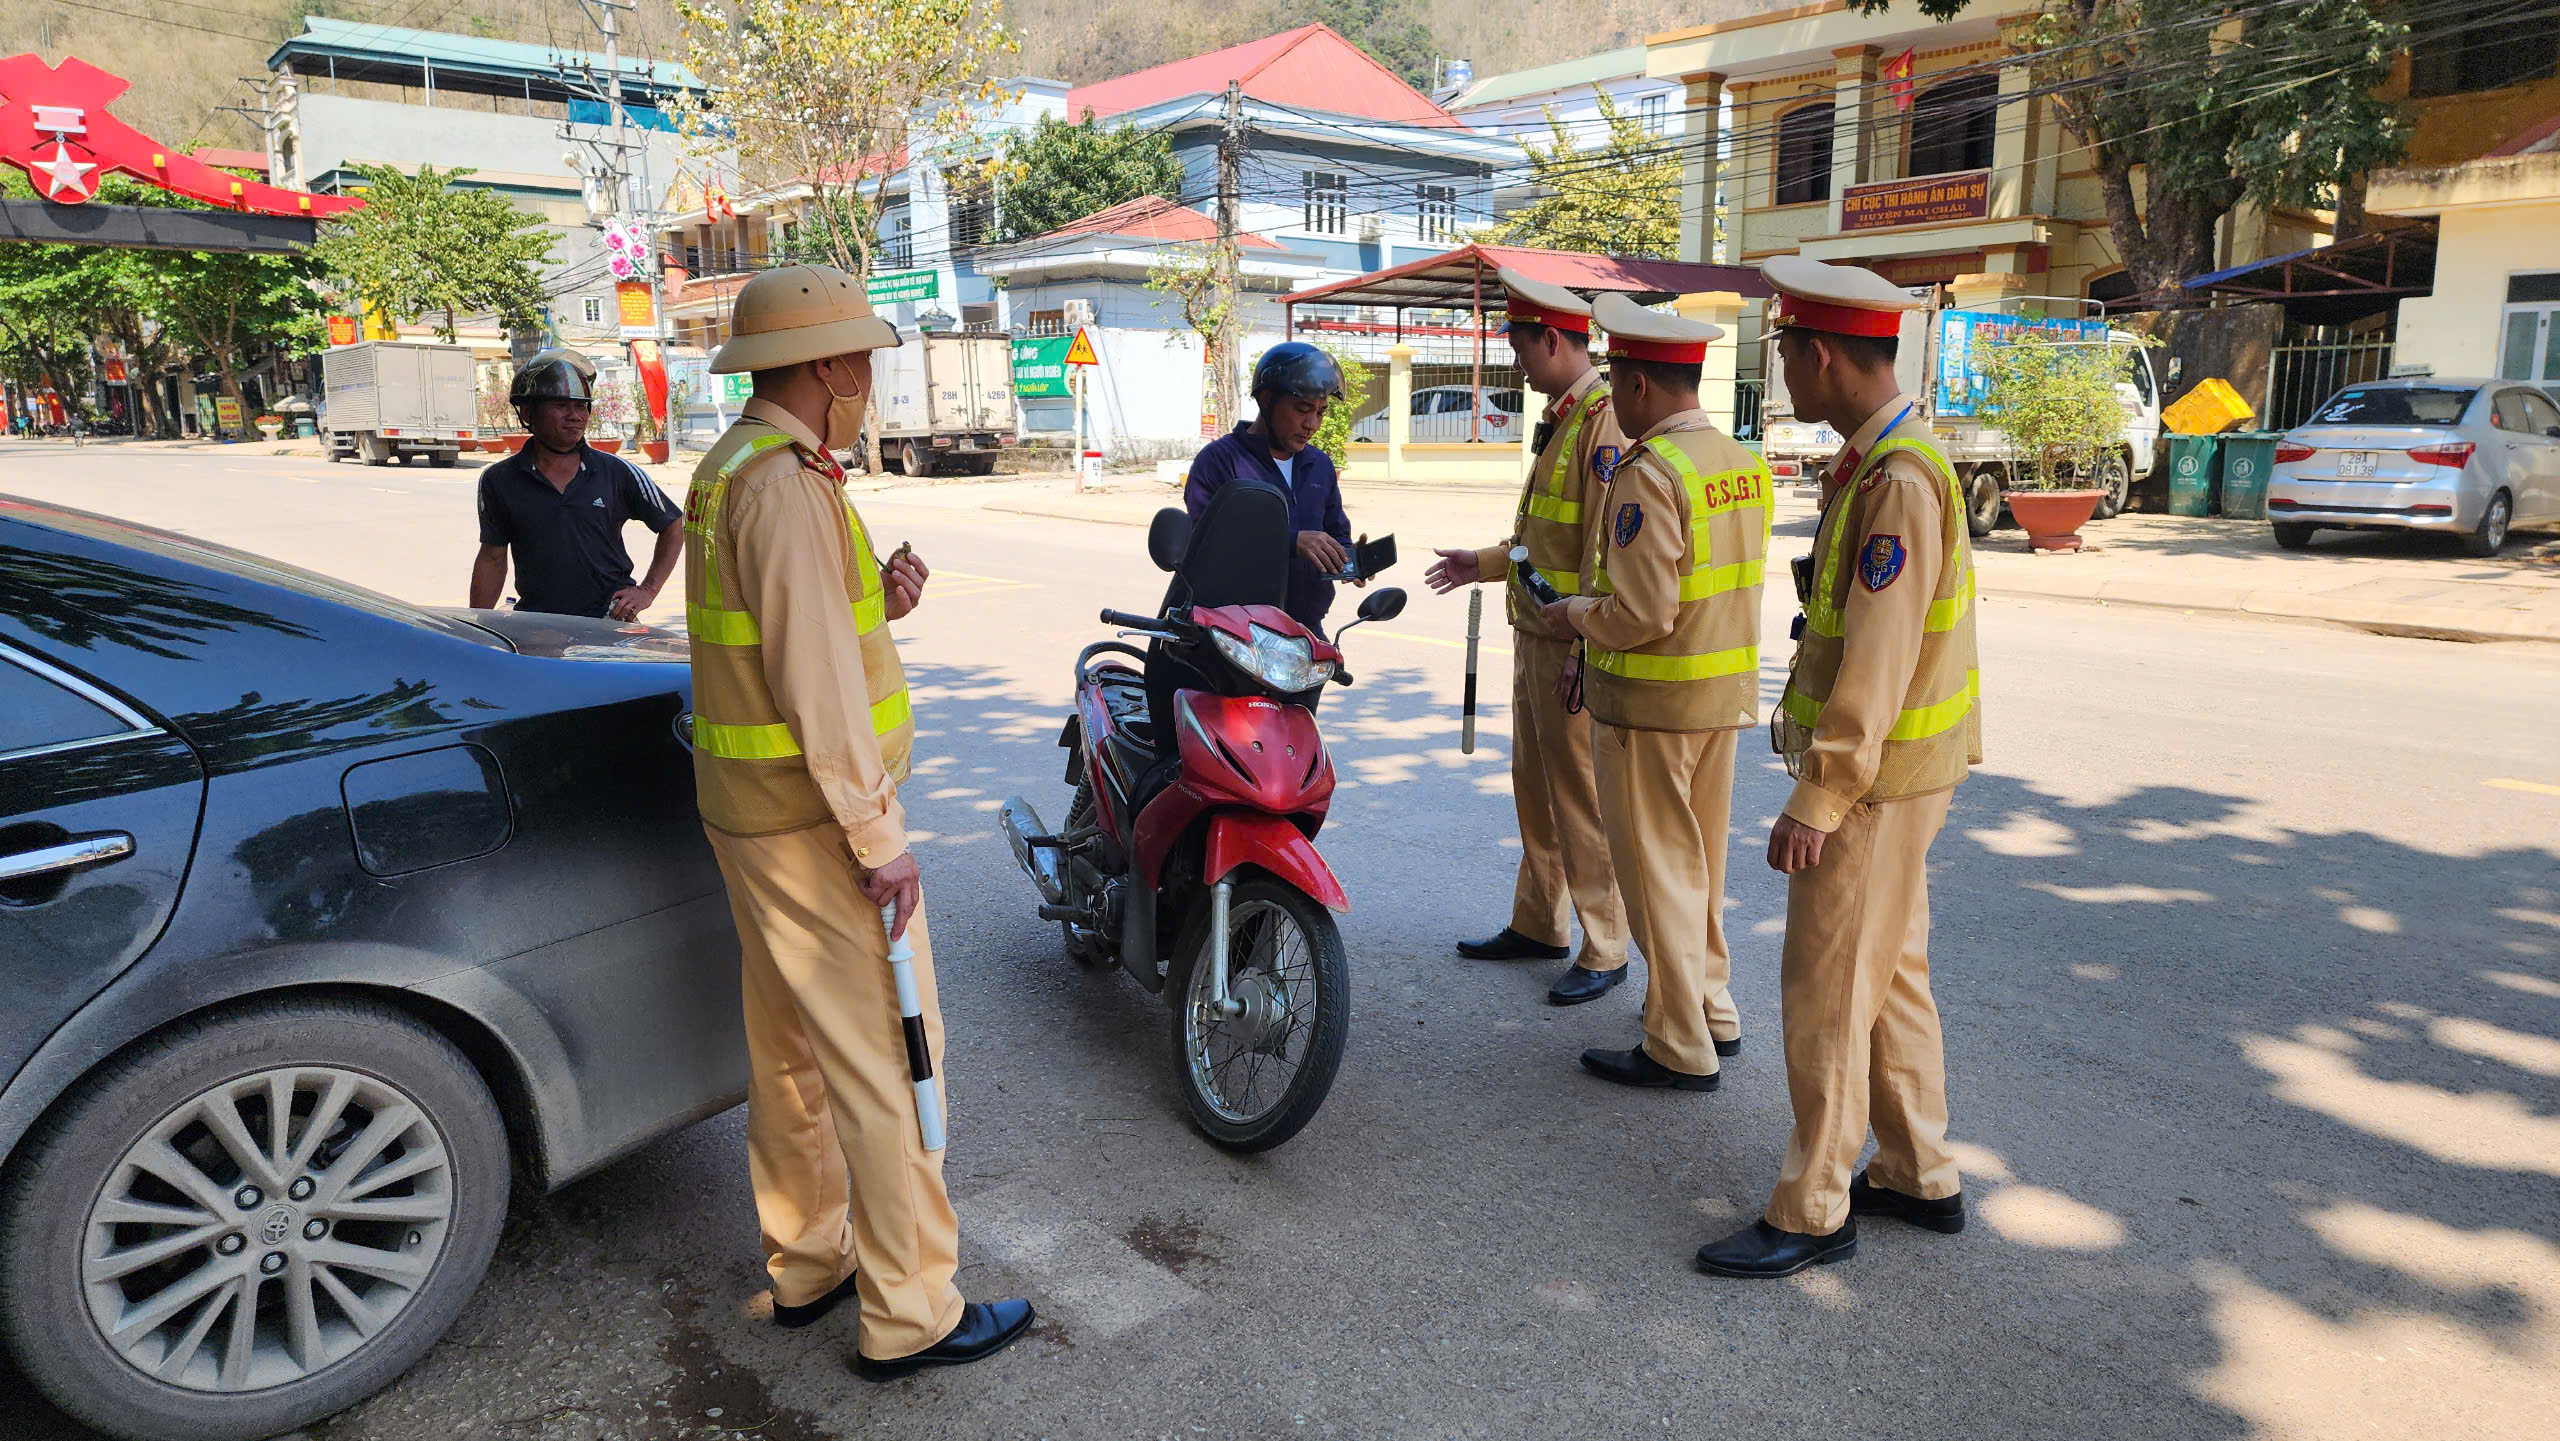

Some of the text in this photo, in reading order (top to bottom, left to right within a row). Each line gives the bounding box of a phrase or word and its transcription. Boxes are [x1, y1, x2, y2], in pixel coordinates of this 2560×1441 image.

[1845, 180, 1986, 212] CHI CỤC THI HÀNH ÁN DÂN SỰ
[1904, 207, 1929, 217] MAI
[1931, 202, 1968, 215] CHÂU
[942, 391, 958, 400] 28H
[2348, 453, 2368, 464] 28A
[1248, 701, 1281, 713] HONDA
[1178, 783, 1203, 802] HONDA
